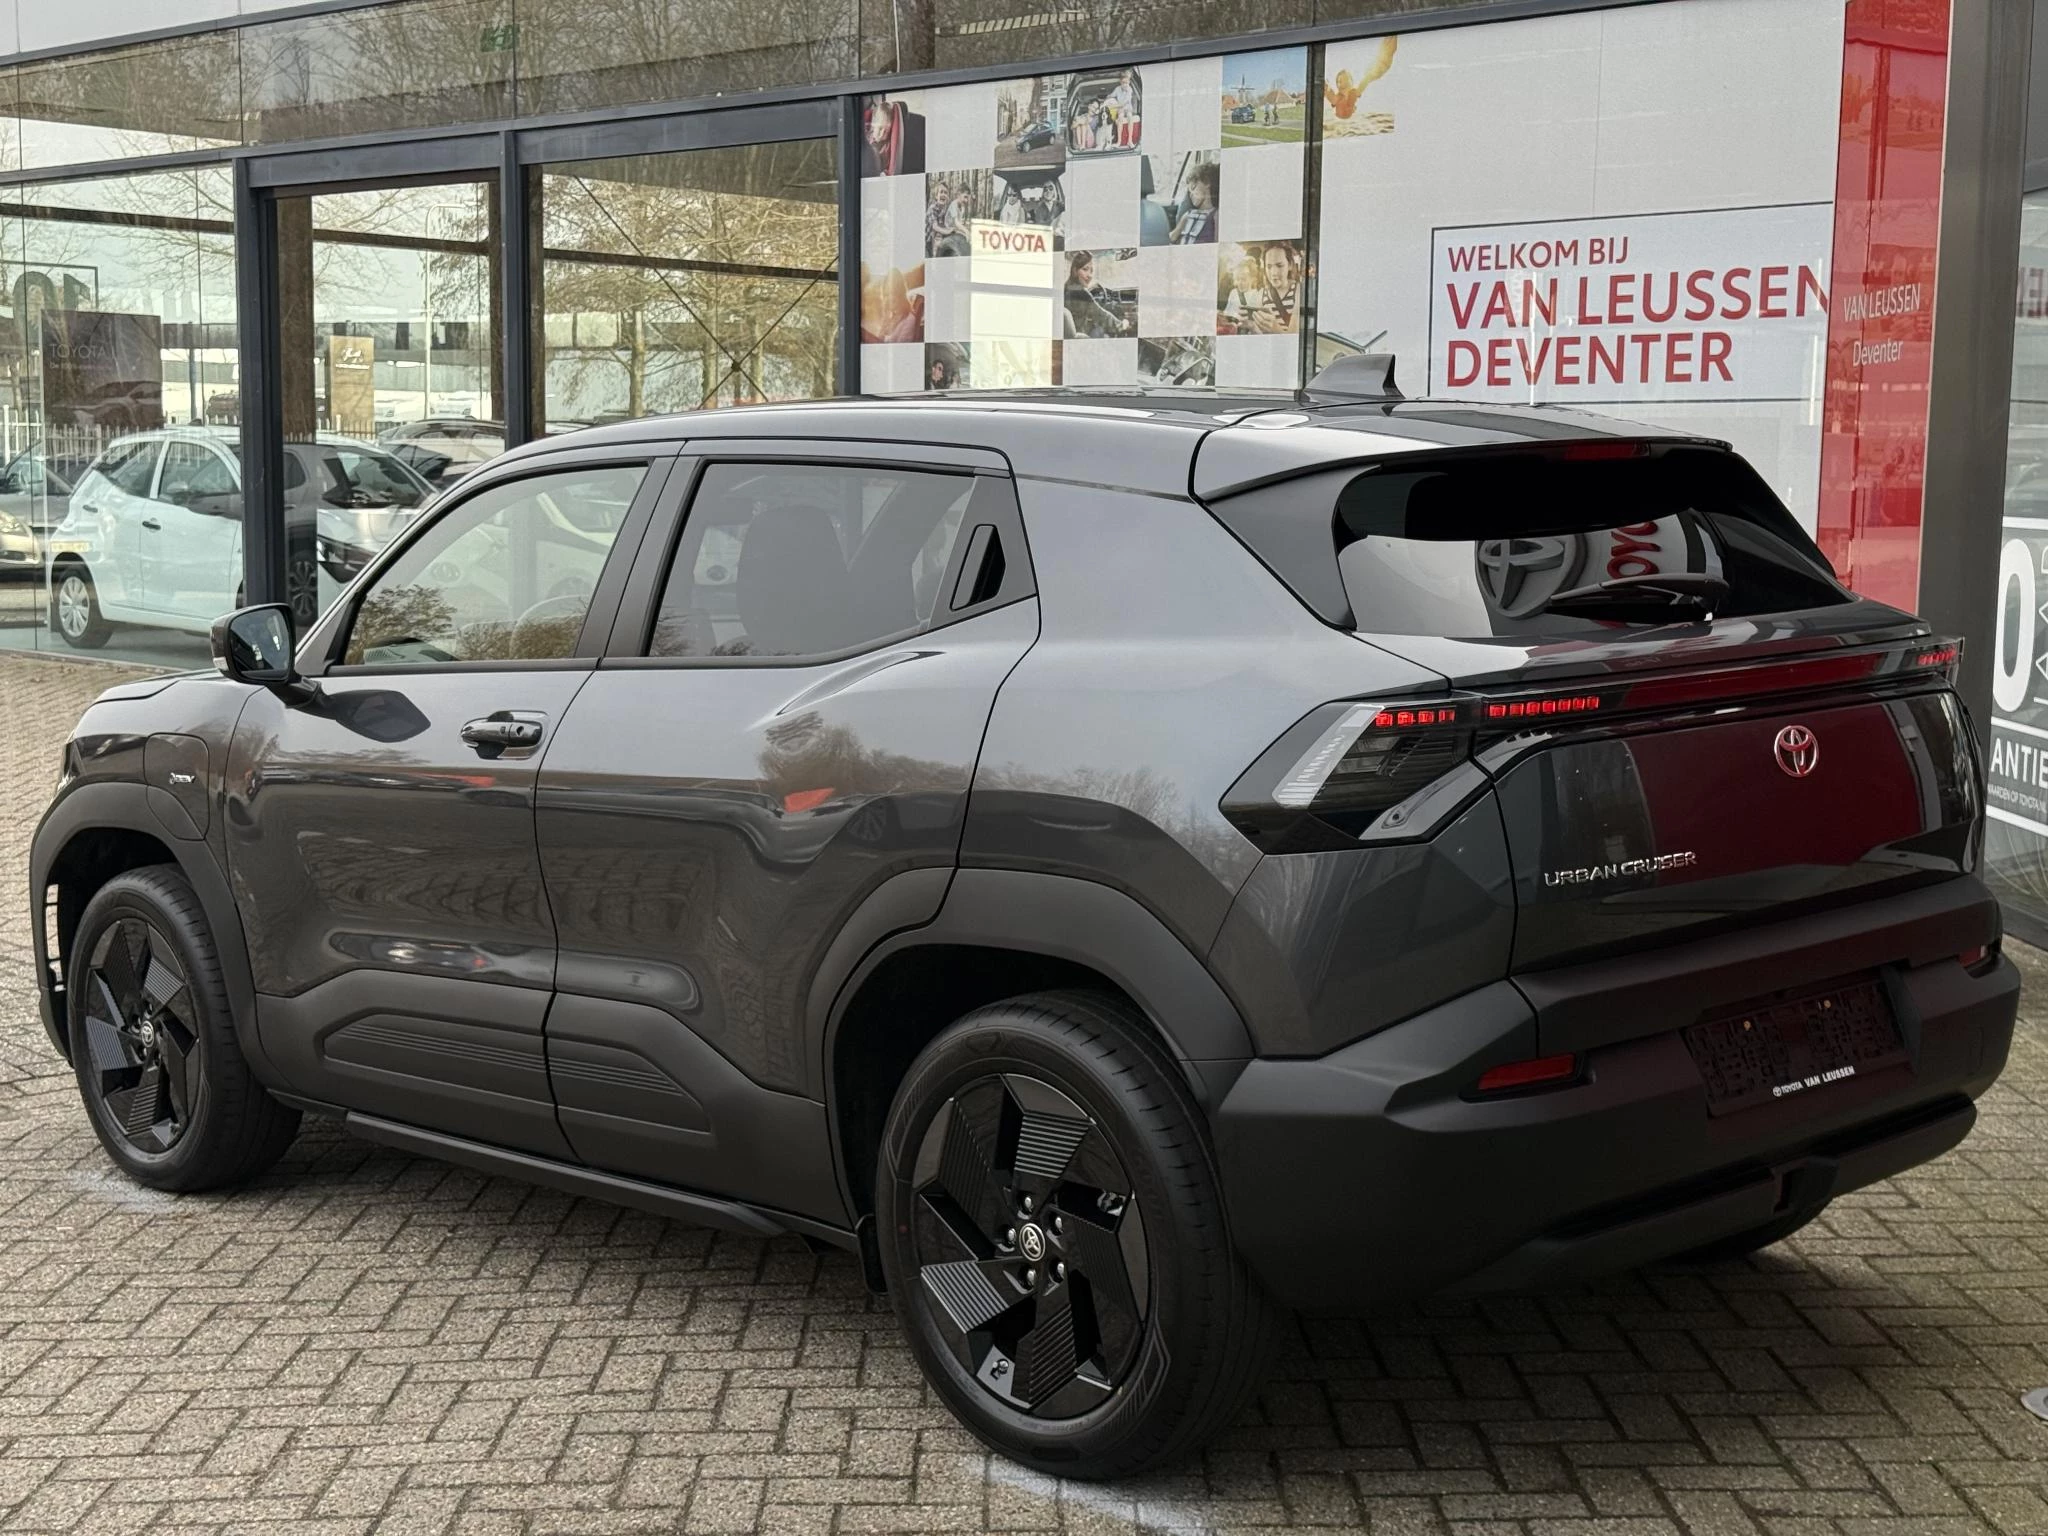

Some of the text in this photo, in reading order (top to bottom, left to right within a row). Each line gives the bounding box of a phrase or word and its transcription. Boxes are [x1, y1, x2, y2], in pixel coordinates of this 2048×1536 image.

[979, 230, 1046, 252] TOYOTA
[1447, 236, 1629, 273] WELKOM BIJ
[1446, 264, 1830, 330] VAN LEUSSEN
[1843, 282, 1921, 323] VAN LEUSSEN
[50, 344, 107, 359] TOYOTA
[1447, 331, 1734, 388] DEVENTER
[1852, 337, 1903, 368] Deventer
[1544, 850, 1698, 887] URBAN CRUISER
[1804, 1075, 1821, 1088] VAN
[1822, 1065, 1856, 1083] LEUSSEN
